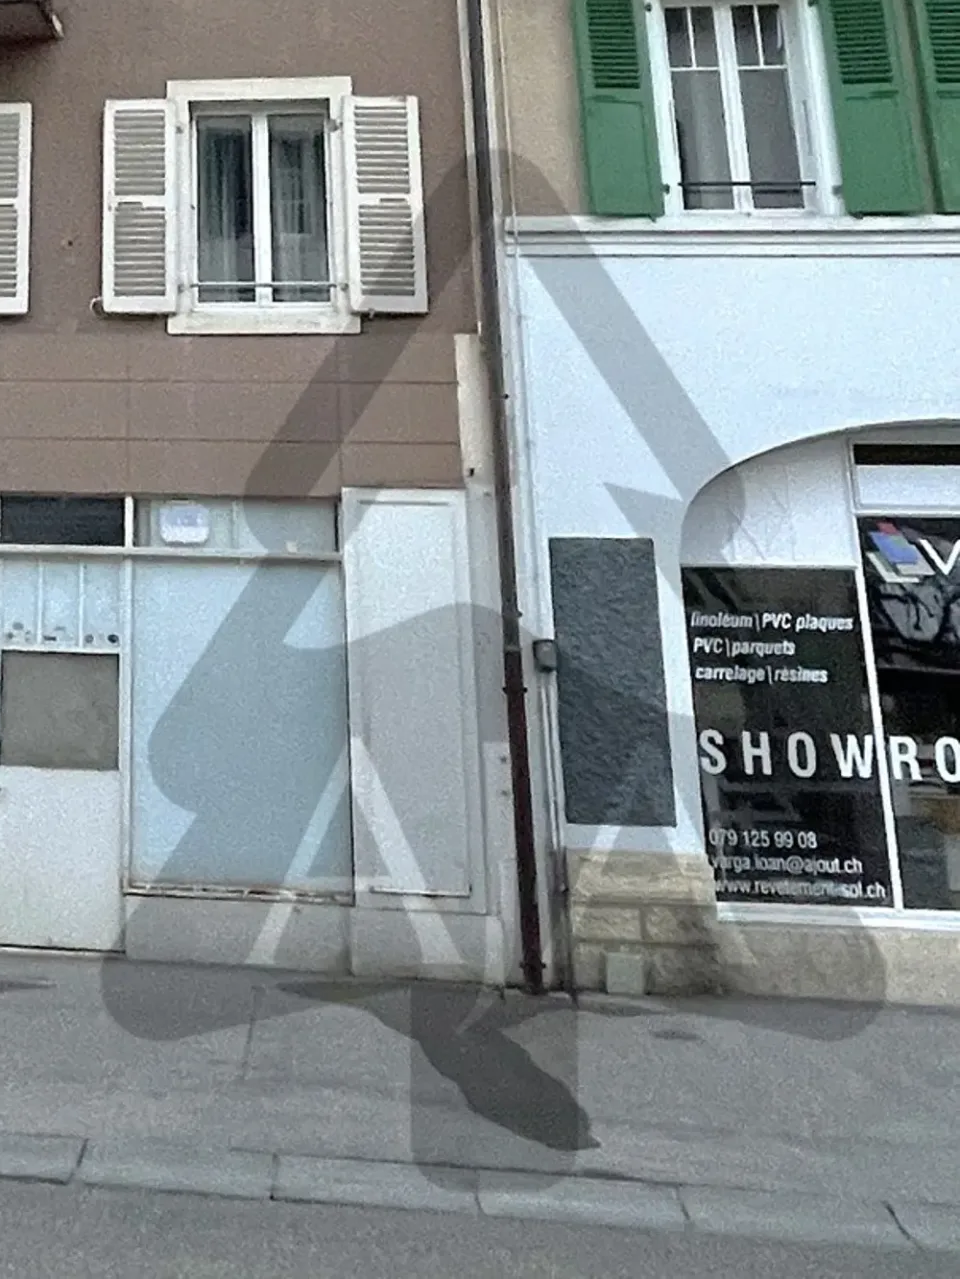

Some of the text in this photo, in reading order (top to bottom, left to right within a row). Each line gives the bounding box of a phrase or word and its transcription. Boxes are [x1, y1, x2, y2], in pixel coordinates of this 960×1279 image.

[795, 613, 854, 633] plaques
[708, 828, 738, 846] 079
[743, 830, 770, 847] 125
[797, 831, 818, 849] 08
